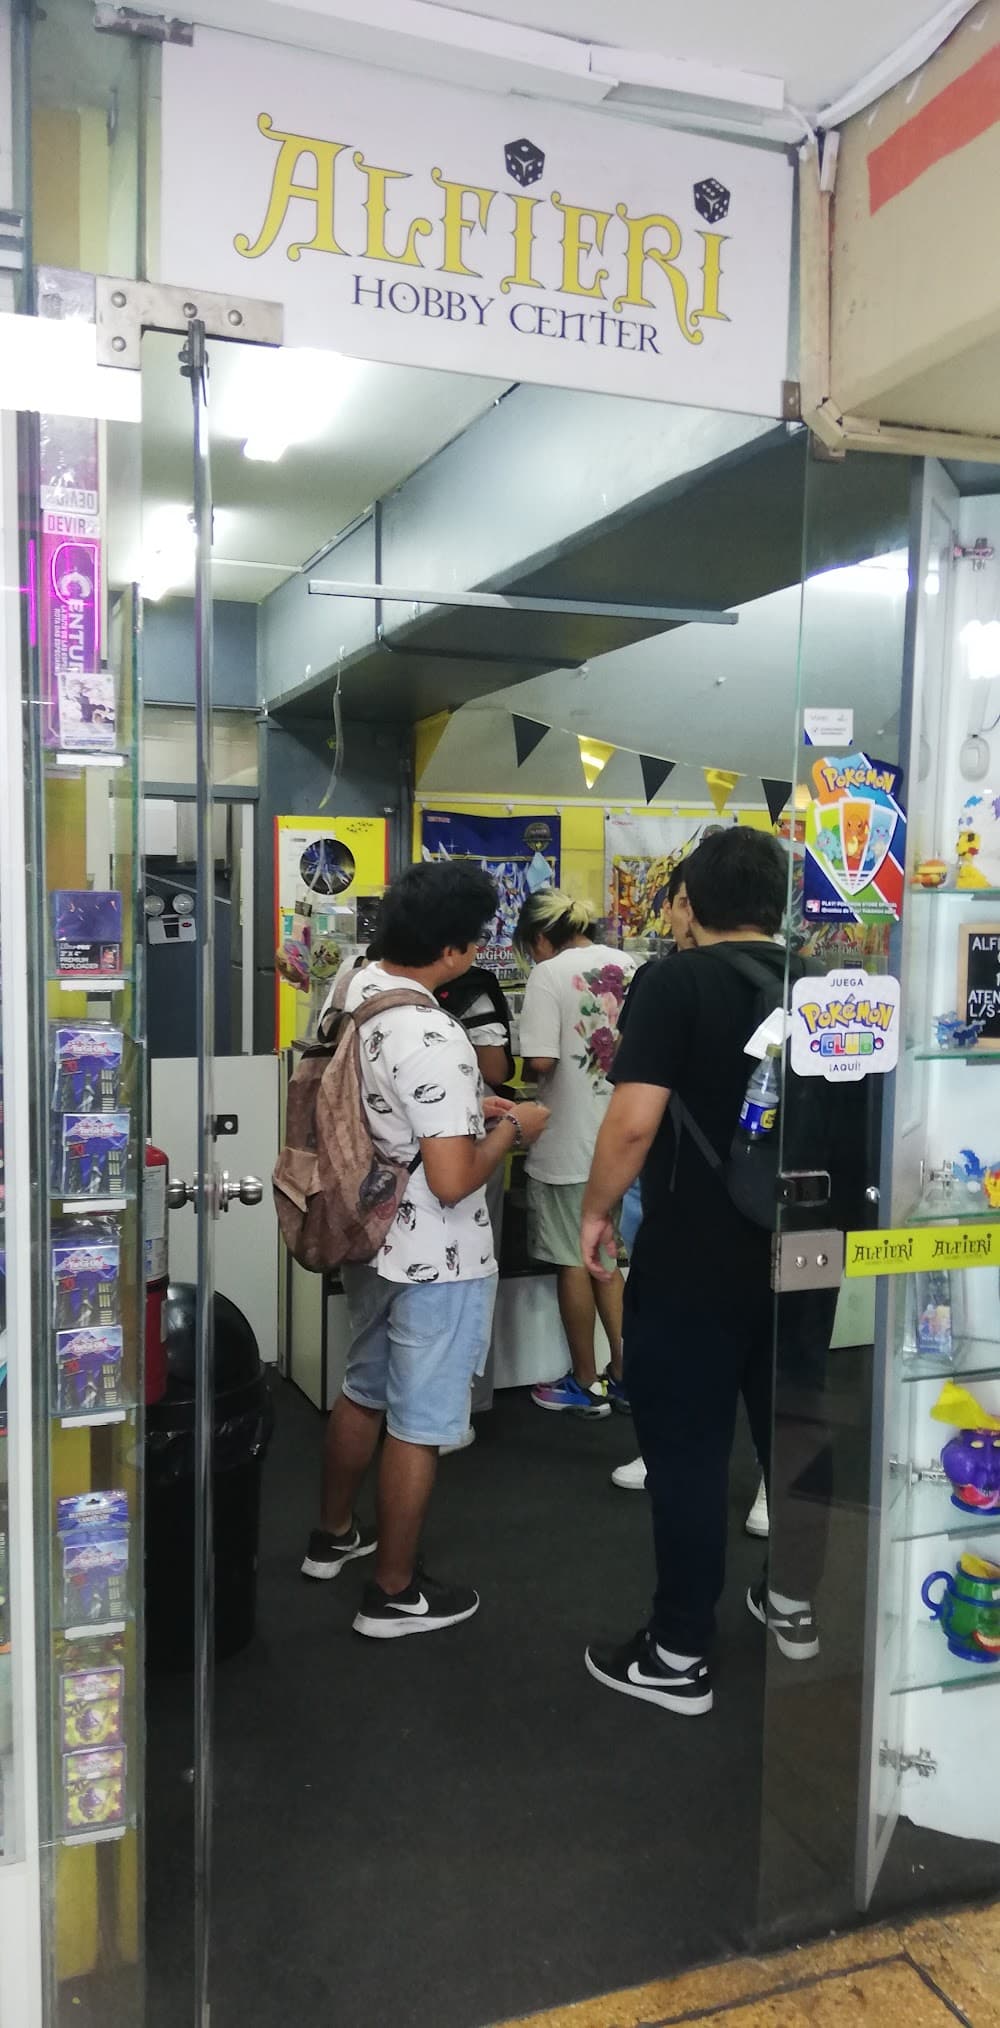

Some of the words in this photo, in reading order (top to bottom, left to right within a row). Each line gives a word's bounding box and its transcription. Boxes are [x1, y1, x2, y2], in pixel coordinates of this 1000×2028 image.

[233, 112, 732, 345] ALFIERI
[353, 274, 496, 328] HOBBY
[509, 301, 662, 355] CENTER
[47, 515, 86, 534] DEVIR
[830, 978, 864, 987] JUEGA
[820, 1032, 874, 1057] CLUB
[829, 1060, 861, 1072] ¡AQUÍ!
[852, 1238, 913, 1262] ALFIERI
[932, 1233, 992, 1258] ALFIERI
